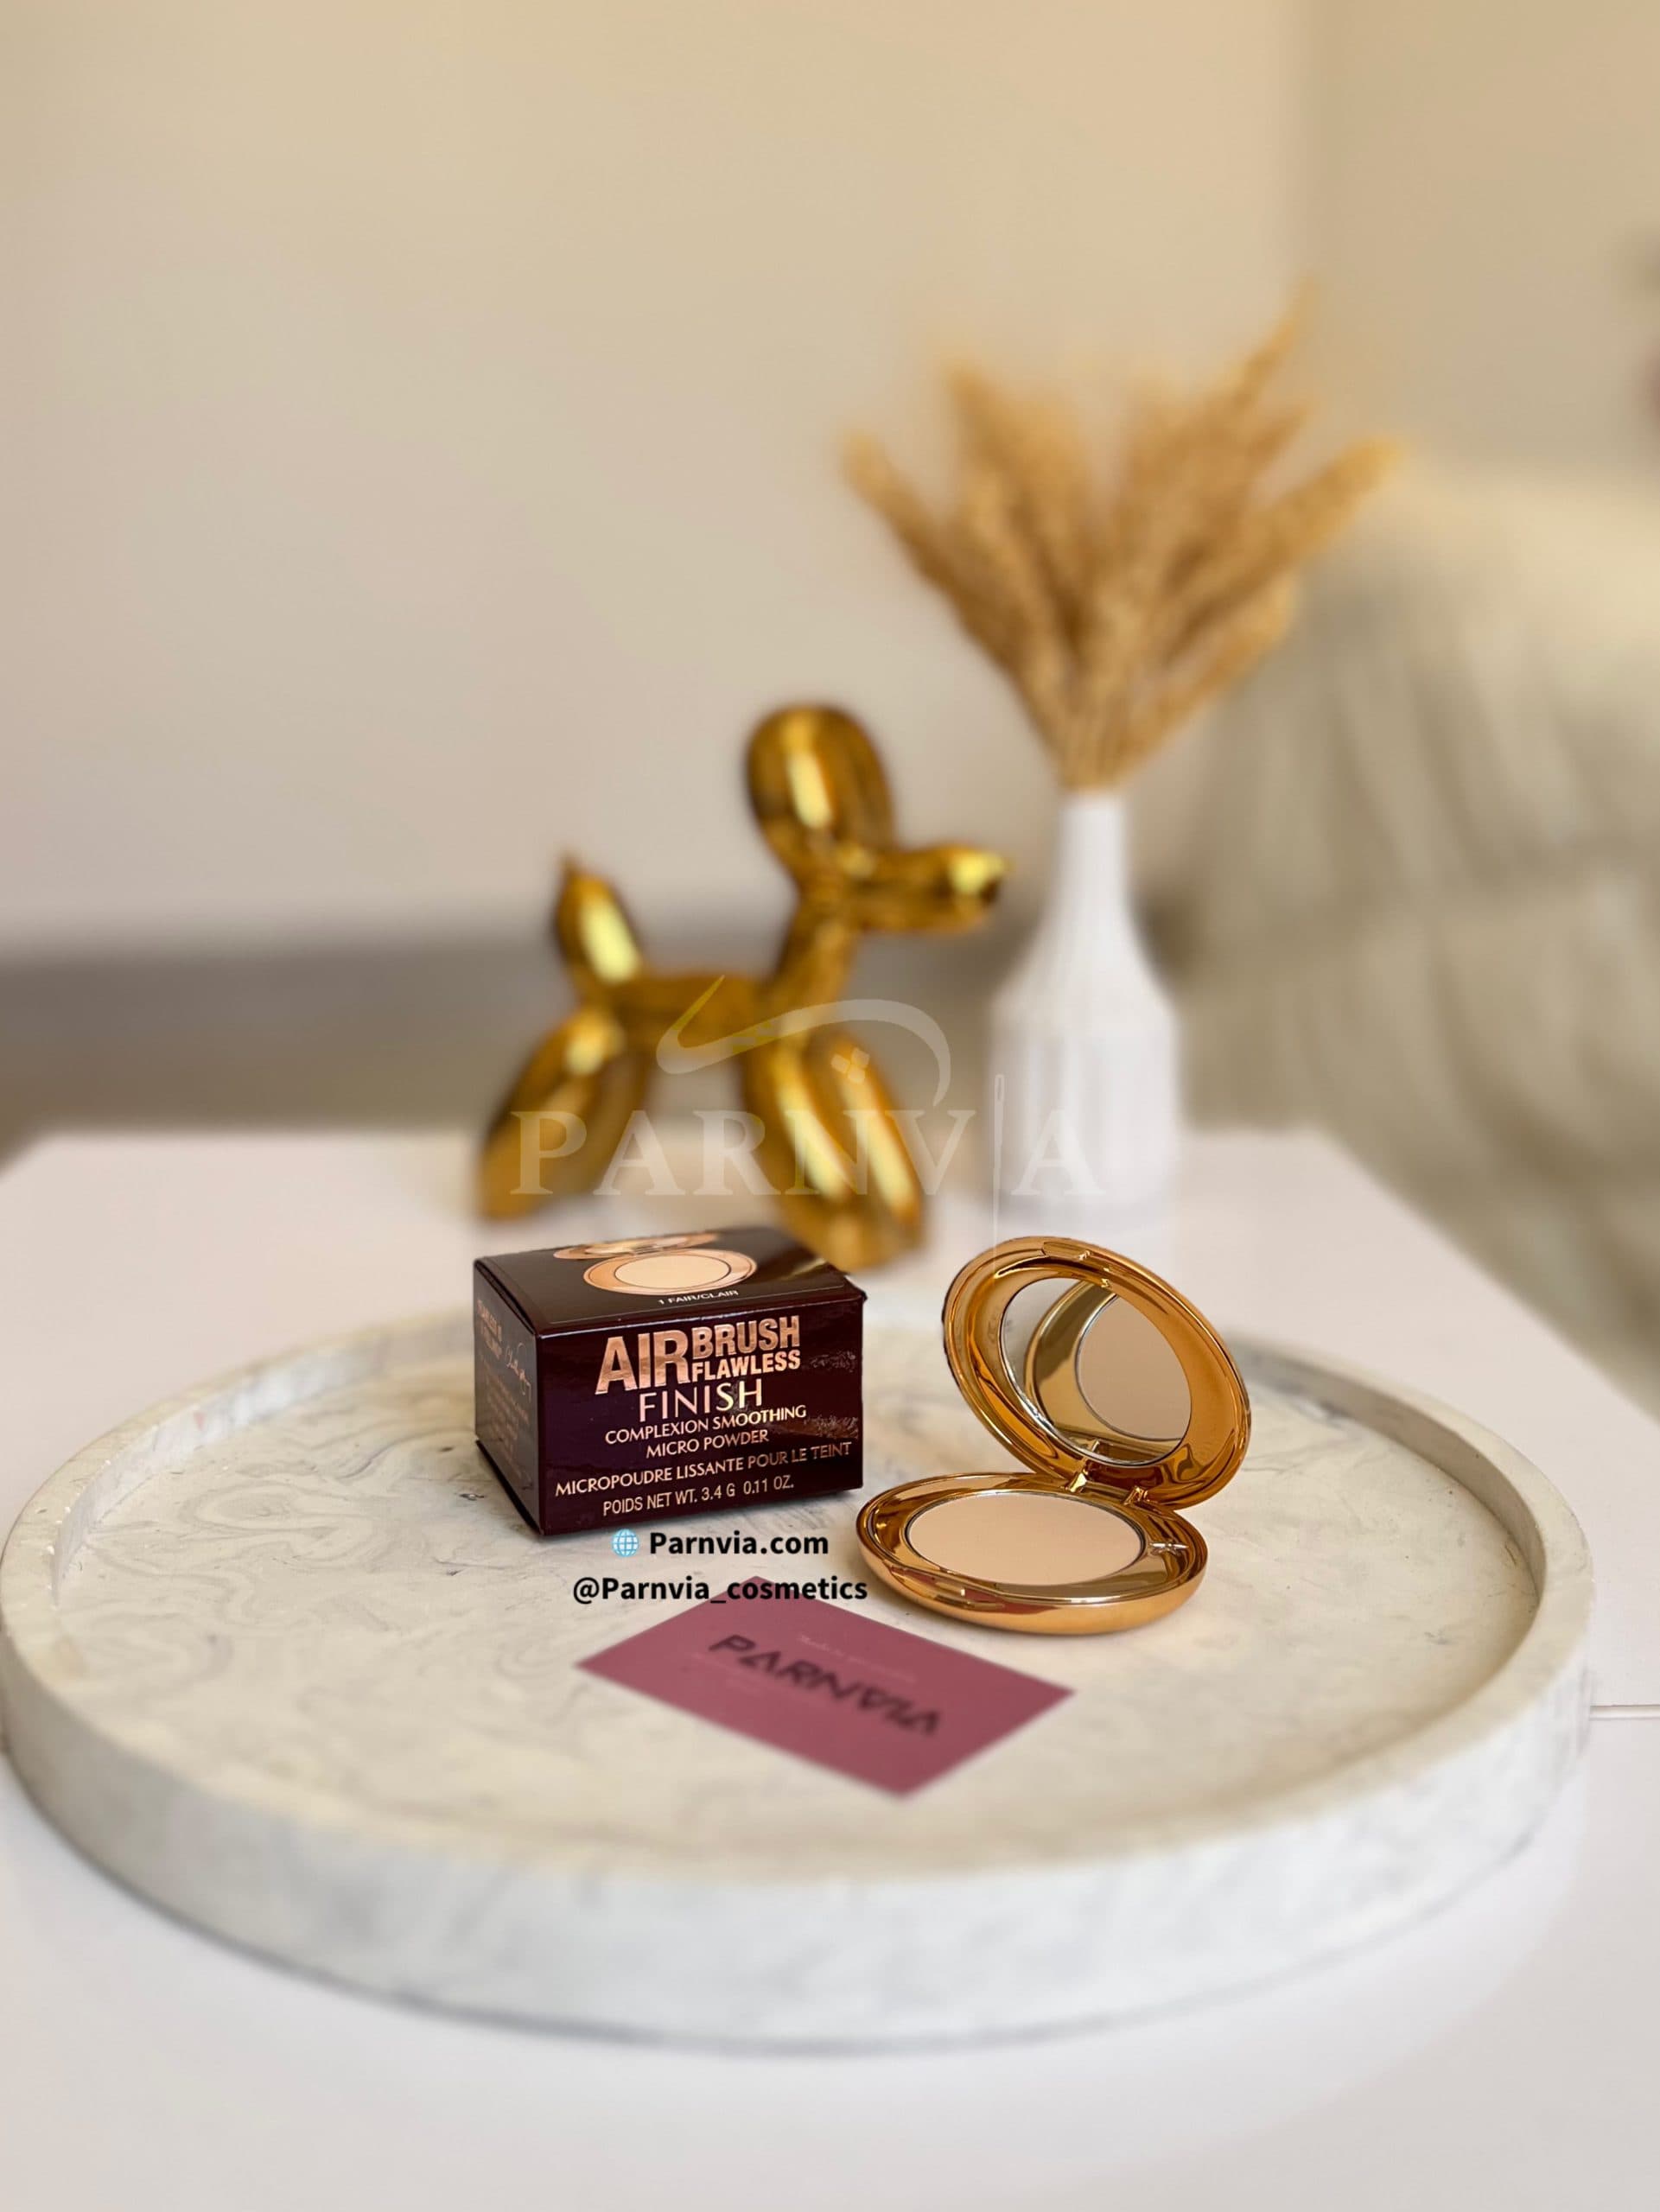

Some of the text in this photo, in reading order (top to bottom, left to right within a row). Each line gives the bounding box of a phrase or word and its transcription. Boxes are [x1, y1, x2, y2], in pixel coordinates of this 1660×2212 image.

[667, 1289, 740, 1304] FAIR/CLAIR
[692, 1349, 801, 1382] FLAWLESS
[639, 1378, 762, 1422] FINISH
[605, 1404, 806, 1445] COMPLEXION SMOOTHING
[646, 1428, 769, 1459] MICRO POWDER
[555, 1441, 852, 1497] MICROPOUDRE LISSANTE POUR LE TEINT
[603, 1474, 794, 1516] POIDS NET WT. 3.4 G 0.11 OZ.
